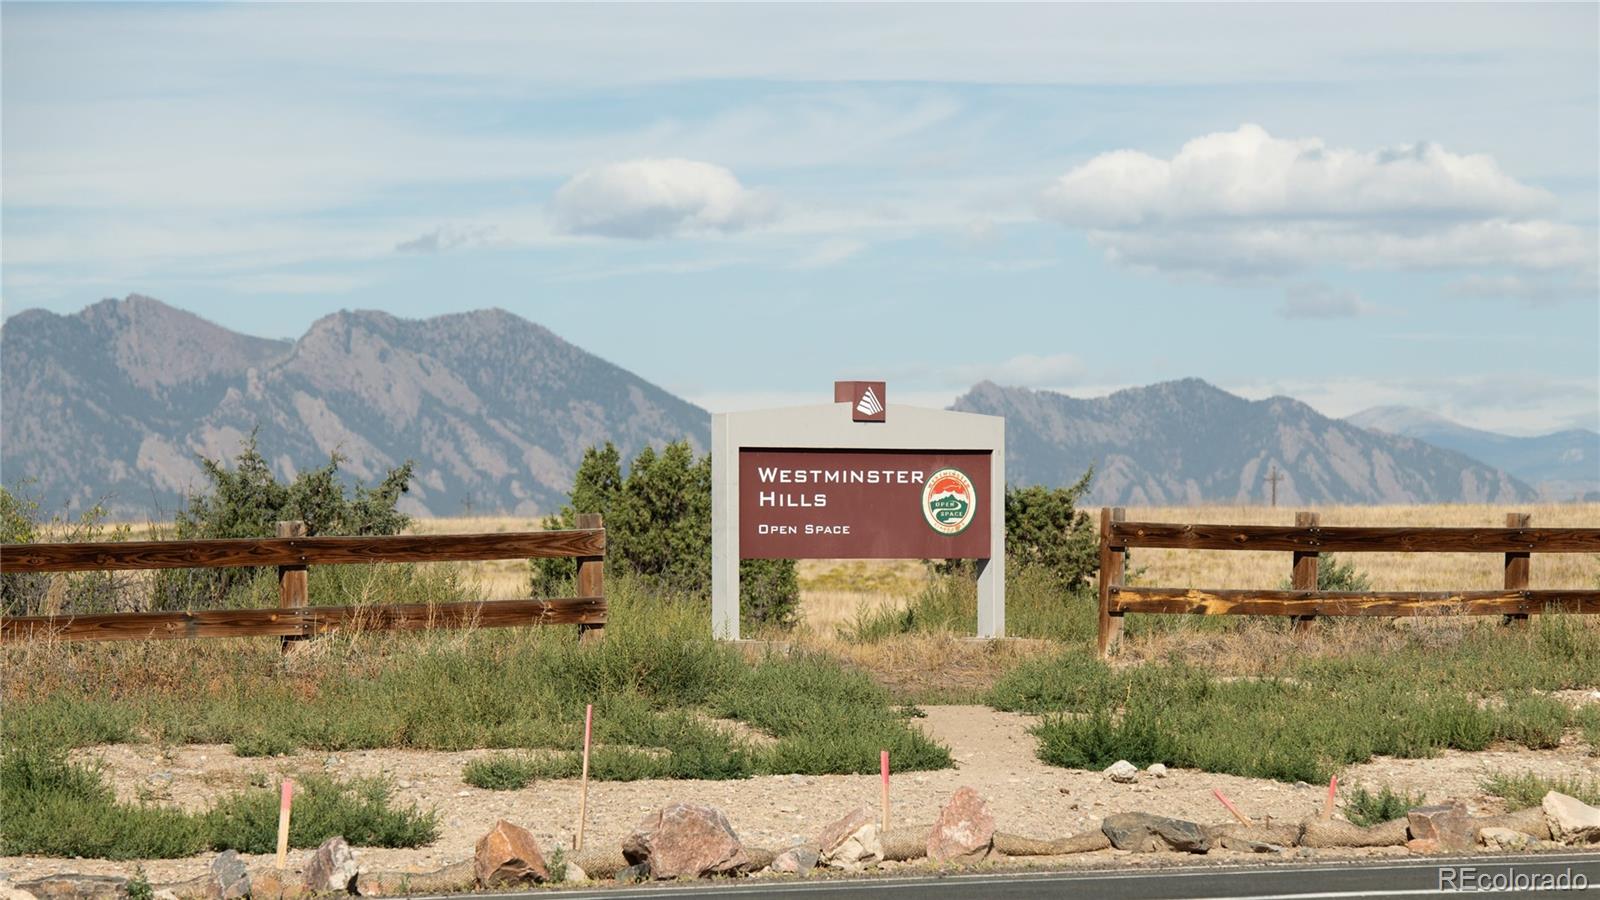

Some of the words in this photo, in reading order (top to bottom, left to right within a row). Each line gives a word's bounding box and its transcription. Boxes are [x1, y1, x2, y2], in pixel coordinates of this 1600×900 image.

[758, 467, 924, 484] WESTMINSTER
[759, 491, 827, 507] HILLS
[758, 524, 797, 534] OPEN
[804, 524, 850, 534] SPACE
